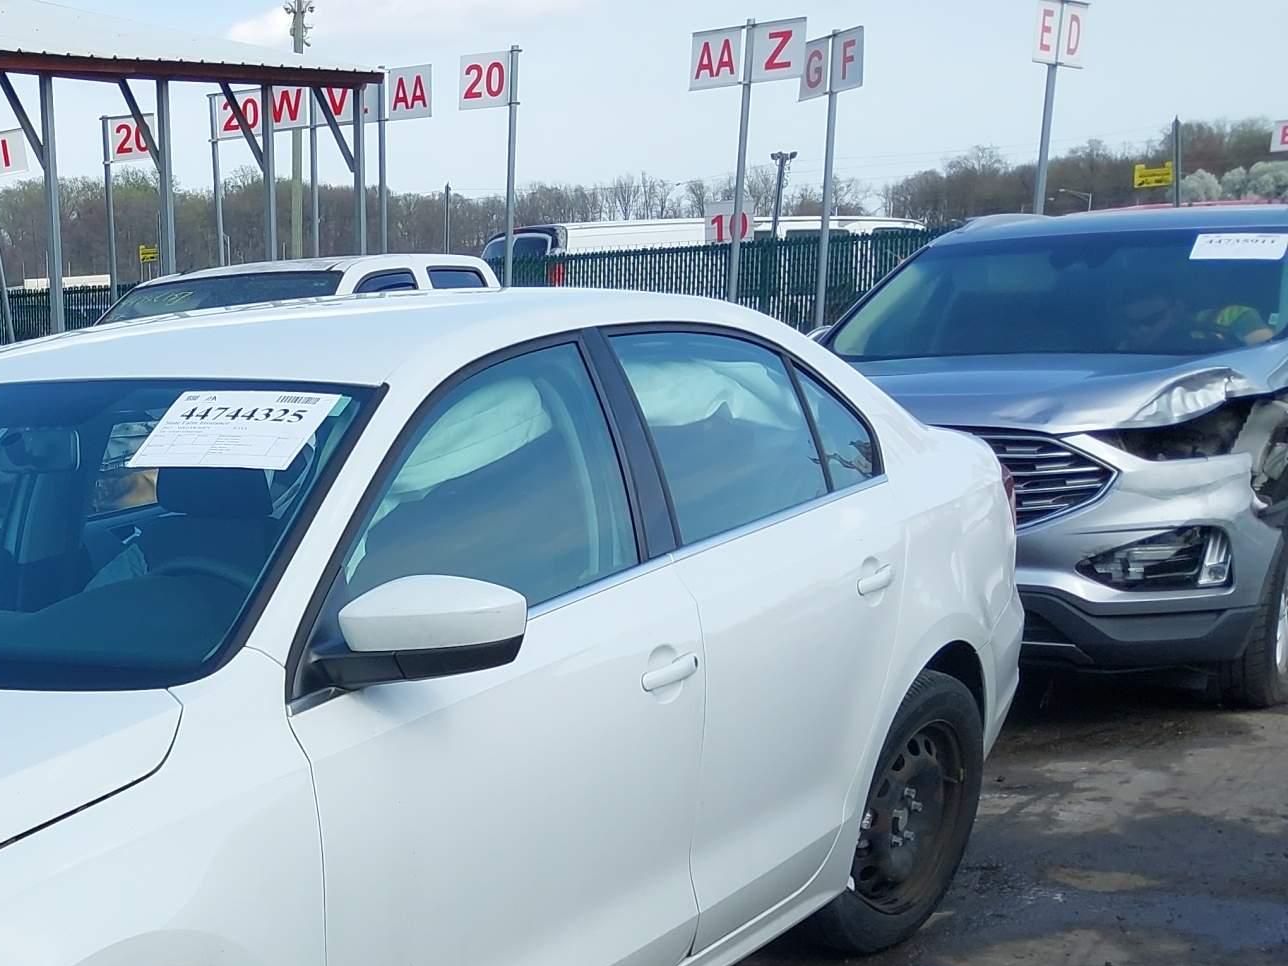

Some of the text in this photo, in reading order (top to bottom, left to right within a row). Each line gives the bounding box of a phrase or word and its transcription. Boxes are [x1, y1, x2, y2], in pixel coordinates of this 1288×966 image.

[1039, 8, 1055, 52] E
[1066, 13, 1081, 56] D
[694, 38, 735, 80] AA
[764, 29, 793, 71] Z
[805, 49, 823, 89] G
[841, 39, 856, 80] F
[392, 74, 428, 111] AA
[463, 61, 505, 100] 20
[222, 97, 259, 132] 20
[272, 88, 302, 123] W
[0, 139, 11, 168] I
[711, 212, 748, 242] 10
[180, 405, 309, 424] 44744325
